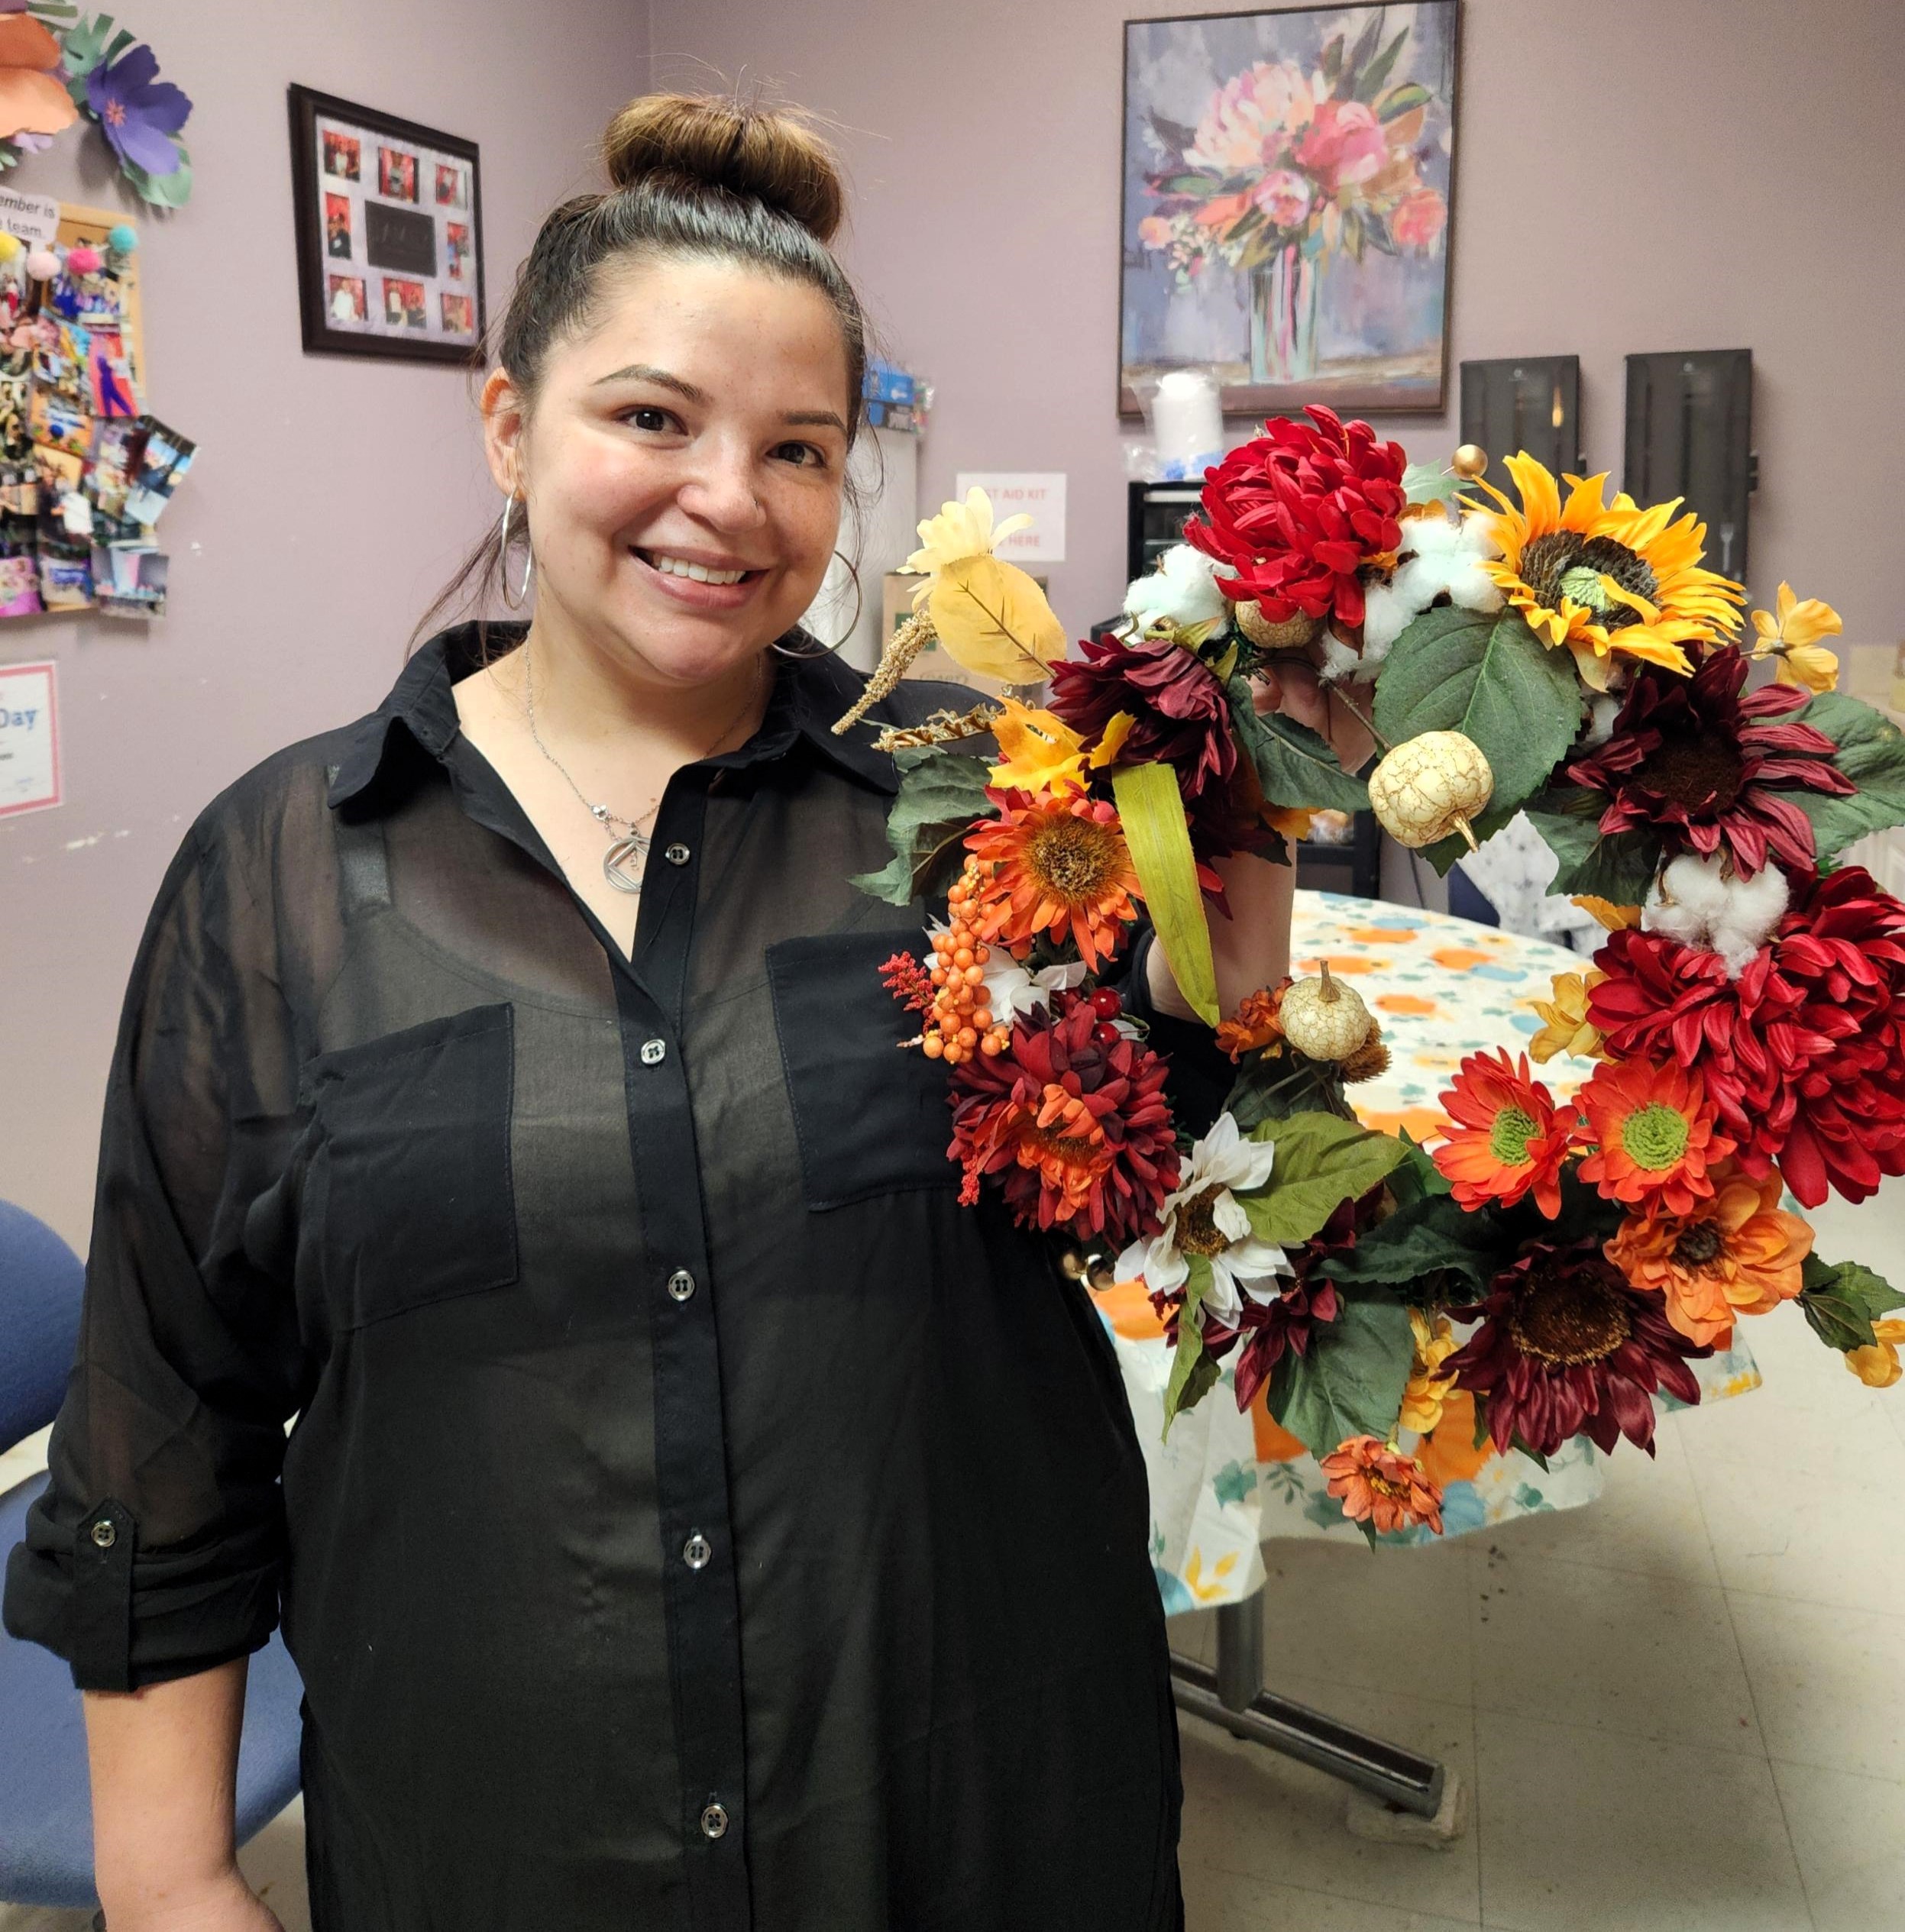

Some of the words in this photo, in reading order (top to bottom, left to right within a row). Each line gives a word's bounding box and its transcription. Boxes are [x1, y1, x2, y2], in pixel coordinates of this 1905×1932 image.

[44, 204, 55, 219] is
[1002, 488, 1024, 499] AID
[1027, 488, 1046, 499] KIT
[1009, 536, 1040, 547] HERE
